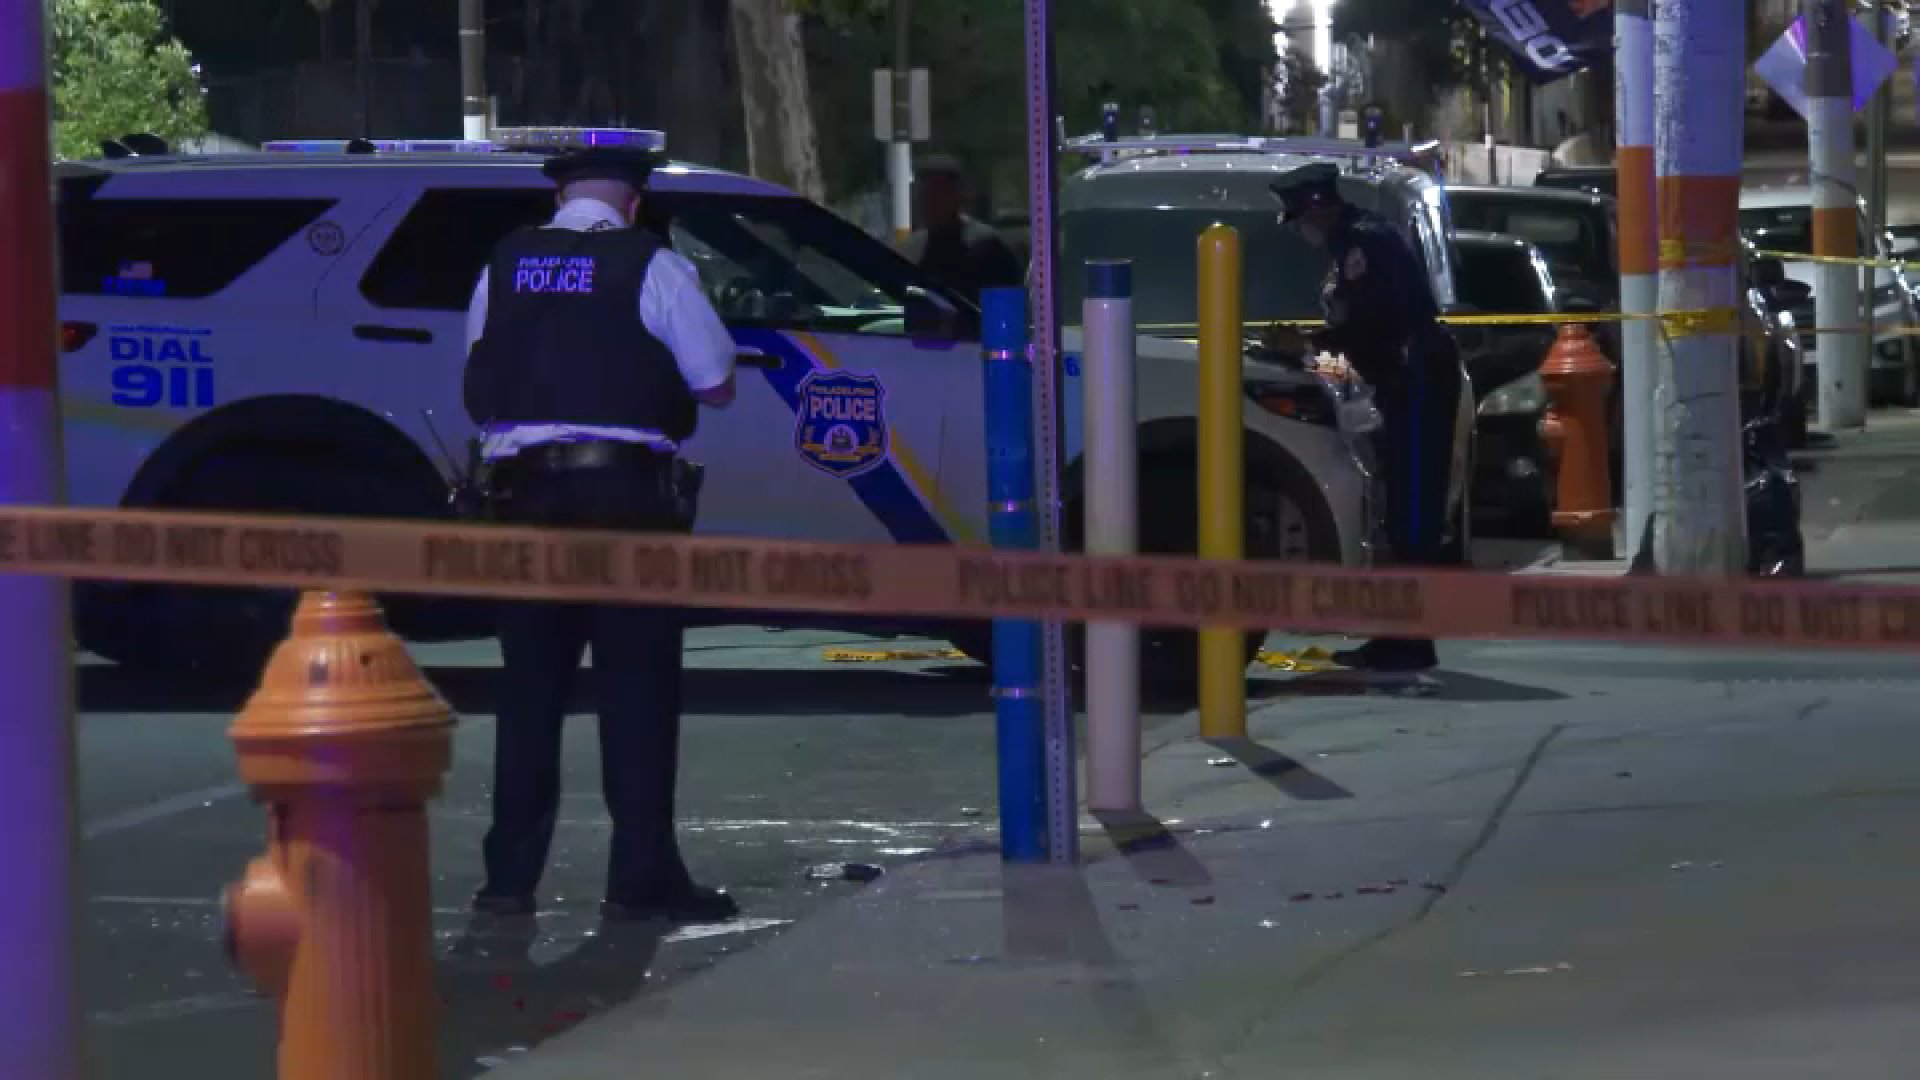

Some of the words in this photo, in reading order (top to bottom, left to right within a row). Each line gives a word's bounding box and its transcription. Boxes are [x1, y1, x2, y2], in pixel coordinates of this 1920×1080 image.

[516, 267, 593, 293] POLICE
[111, 335, 214, 363] DIAL
[111, 365, 214, 408] 911
[809, 396, 877, 421] POLICE
[26, 518, 97, 563] LINE
[112, 522, 155, 566] DO
[164, 526, 226, 569] NOT
[239, 529, 343, 574] CROSS
[423, 534, 537, 582] POLICE
[545, 539, 617, 586] LINE
[634, 543, 680, 588] DO
[690, 547, 752, 592] NOT
[762, 549, 871, 598] CROSS
[959, 557, 1070, 608] POLICE
[1085, 562, 1153, 610] LINE
[1175, 567, 1220, 614] DO
[1232, 569, 1293, 616] NOT
[1310, 573, 1423, 620] CROSS
[1511, 582, 1631, 630] POLICE
[1643, 586, 1721, 634] LINE
[1738, 591, 1785, 636] DO
[1799, 594, 1861, 640] NOT
